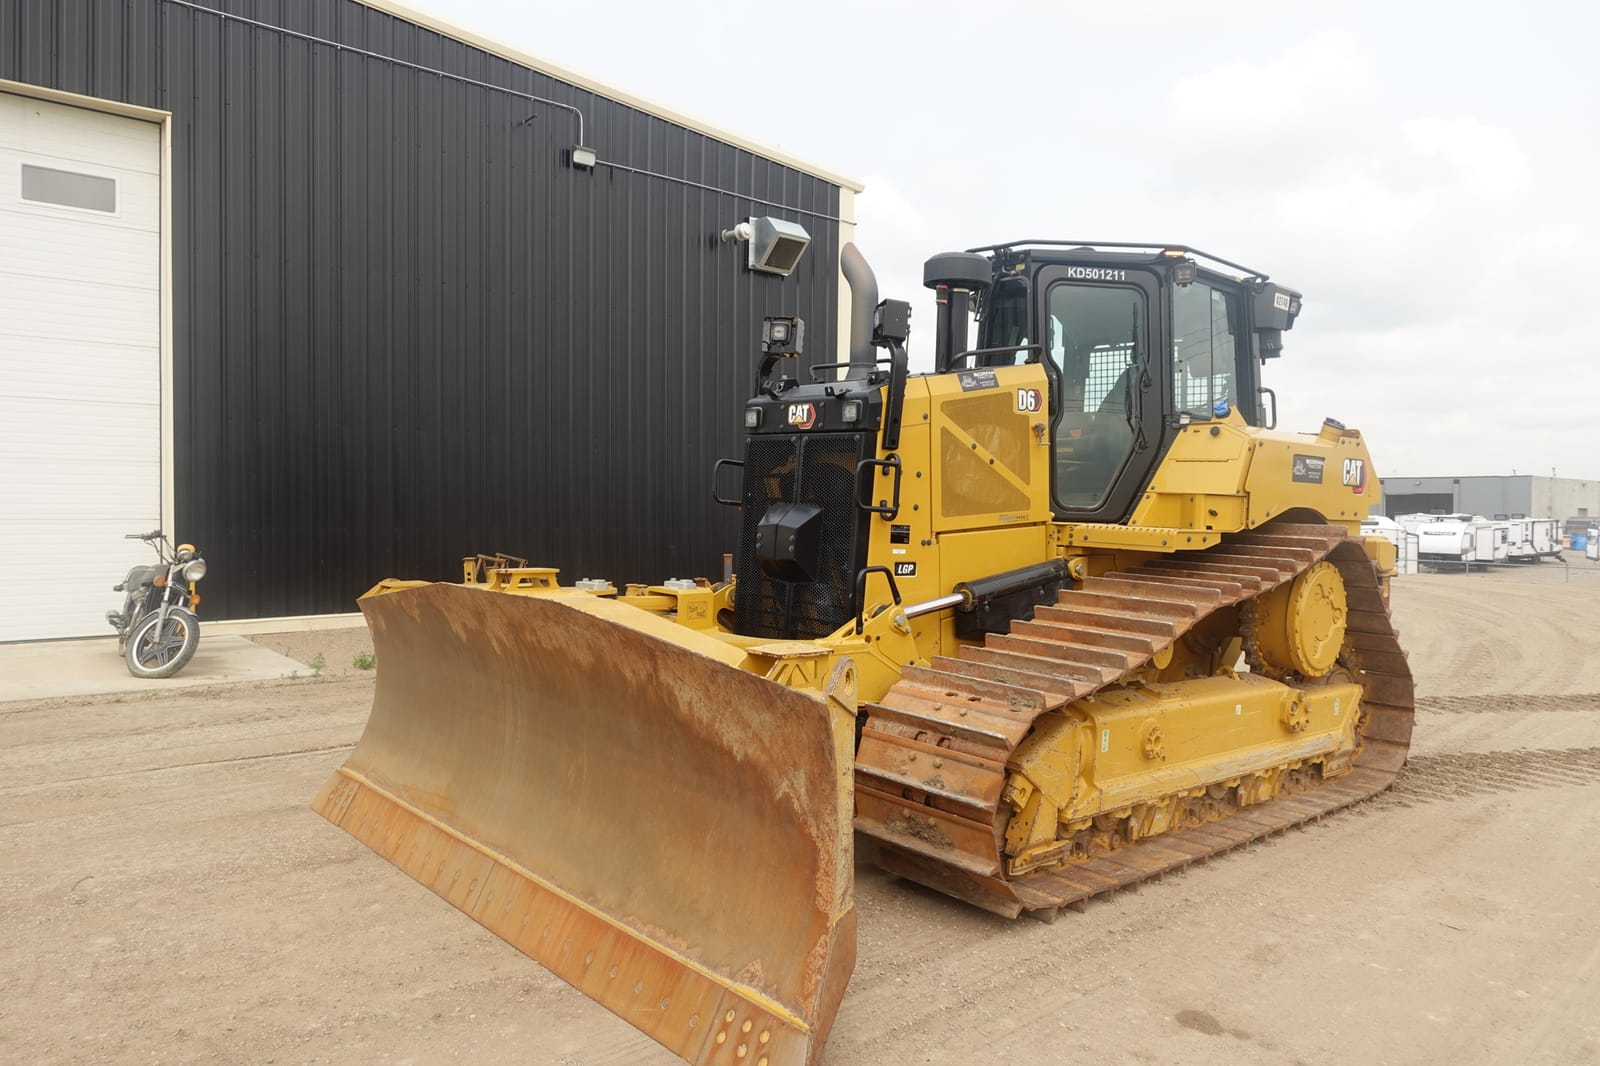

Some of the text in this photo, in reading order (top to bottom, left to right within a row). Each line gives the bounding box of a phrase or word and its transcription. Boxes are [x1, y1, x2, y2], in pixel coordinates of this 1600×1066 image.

[1067, 267, 1125, 281] KD501211
[1018, 390, 1036, 411] D6
[788, 404, 810, 424] CAT
[1343, 459, 1363, 486] CAT
[897, 564, 914, 574] LGP
